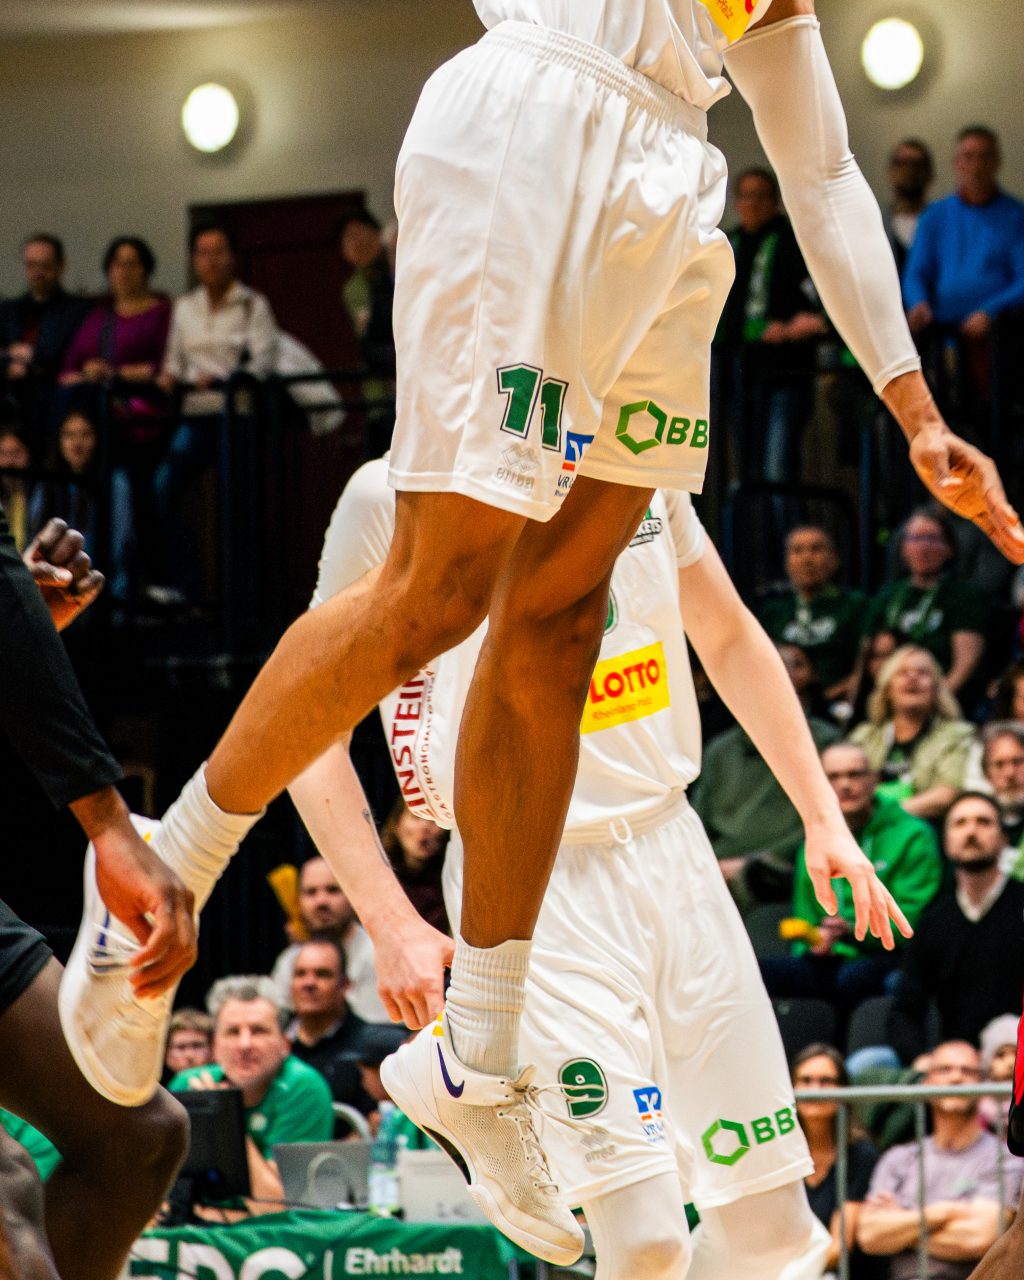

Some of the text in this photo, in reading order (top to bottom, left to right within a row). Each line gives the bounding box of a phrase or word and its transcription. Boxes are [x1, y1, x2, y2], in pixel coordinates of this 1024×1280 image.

[497, 363, 569, 452] 11
[589, 658, 660, 704] LOTTO
[558, 1057, 608, 1120] 9
[751, 1104, 796, 1145] BB
[344, 1246, 464, 1275] Ehrhardt
